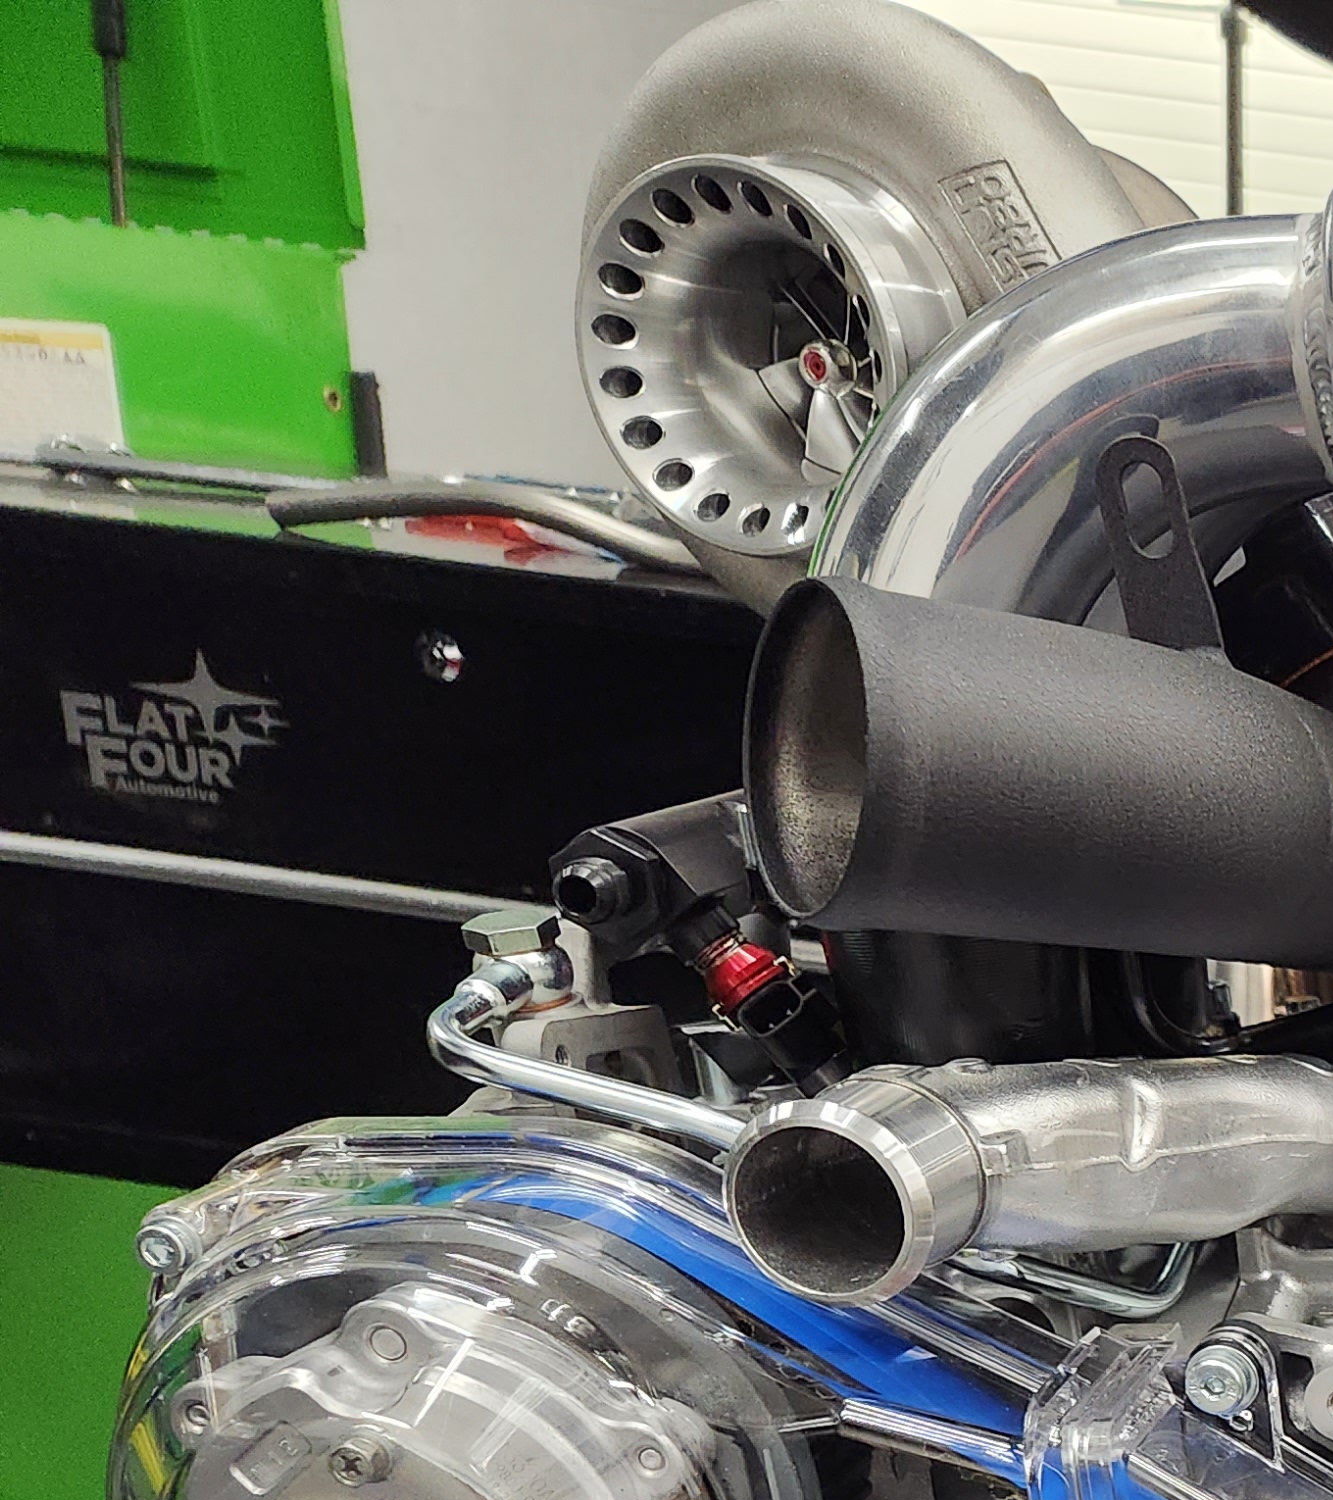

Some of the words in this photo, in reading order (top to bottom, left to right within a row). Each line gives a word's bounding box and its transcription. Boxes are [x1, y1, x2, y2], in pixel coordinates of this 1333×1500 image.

[61, 689, 196, 746] FLAT
[85, 734, 235, 789] FOUR
[115, 776, 220, 804] Automotive
